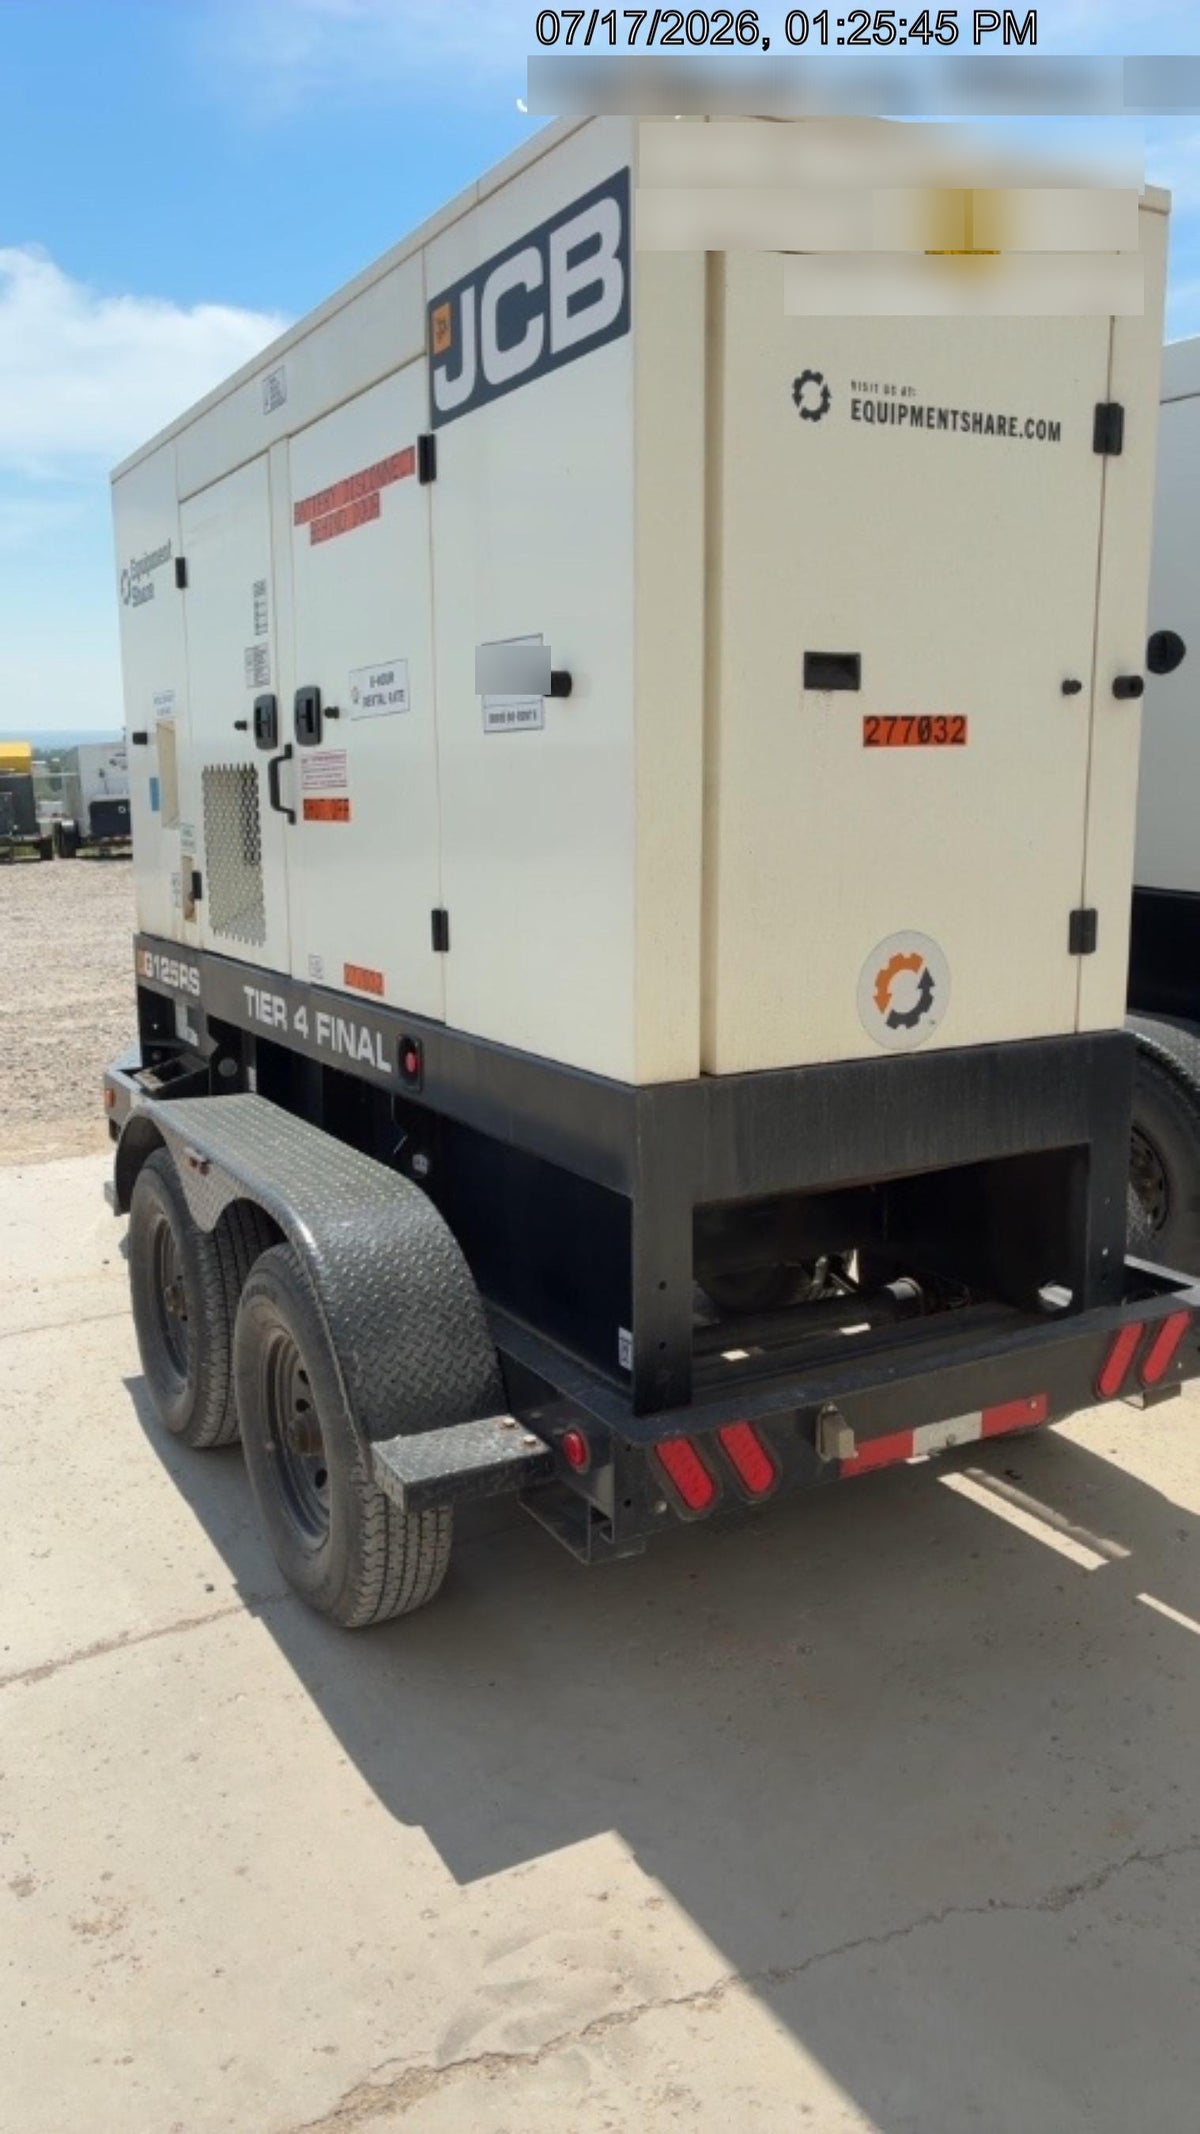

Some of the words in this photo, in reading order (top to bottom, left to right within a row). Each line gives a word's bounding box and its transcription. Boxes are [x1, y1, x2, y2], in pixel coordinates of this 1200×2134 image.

[433, 196, 625, 412] JCB
[850, 380, 879, 394] VISIT
[884, 384, 898, 397] US
[850, 398, 1062, 443] EQUIPMENTSHARE.COM
[864, 715, 967, 747] 277032
[243, 985, 289, 1032] TIER
[293, 1004, 309, 1040] 4
[316, 1011, 392, 1073] FINAL
